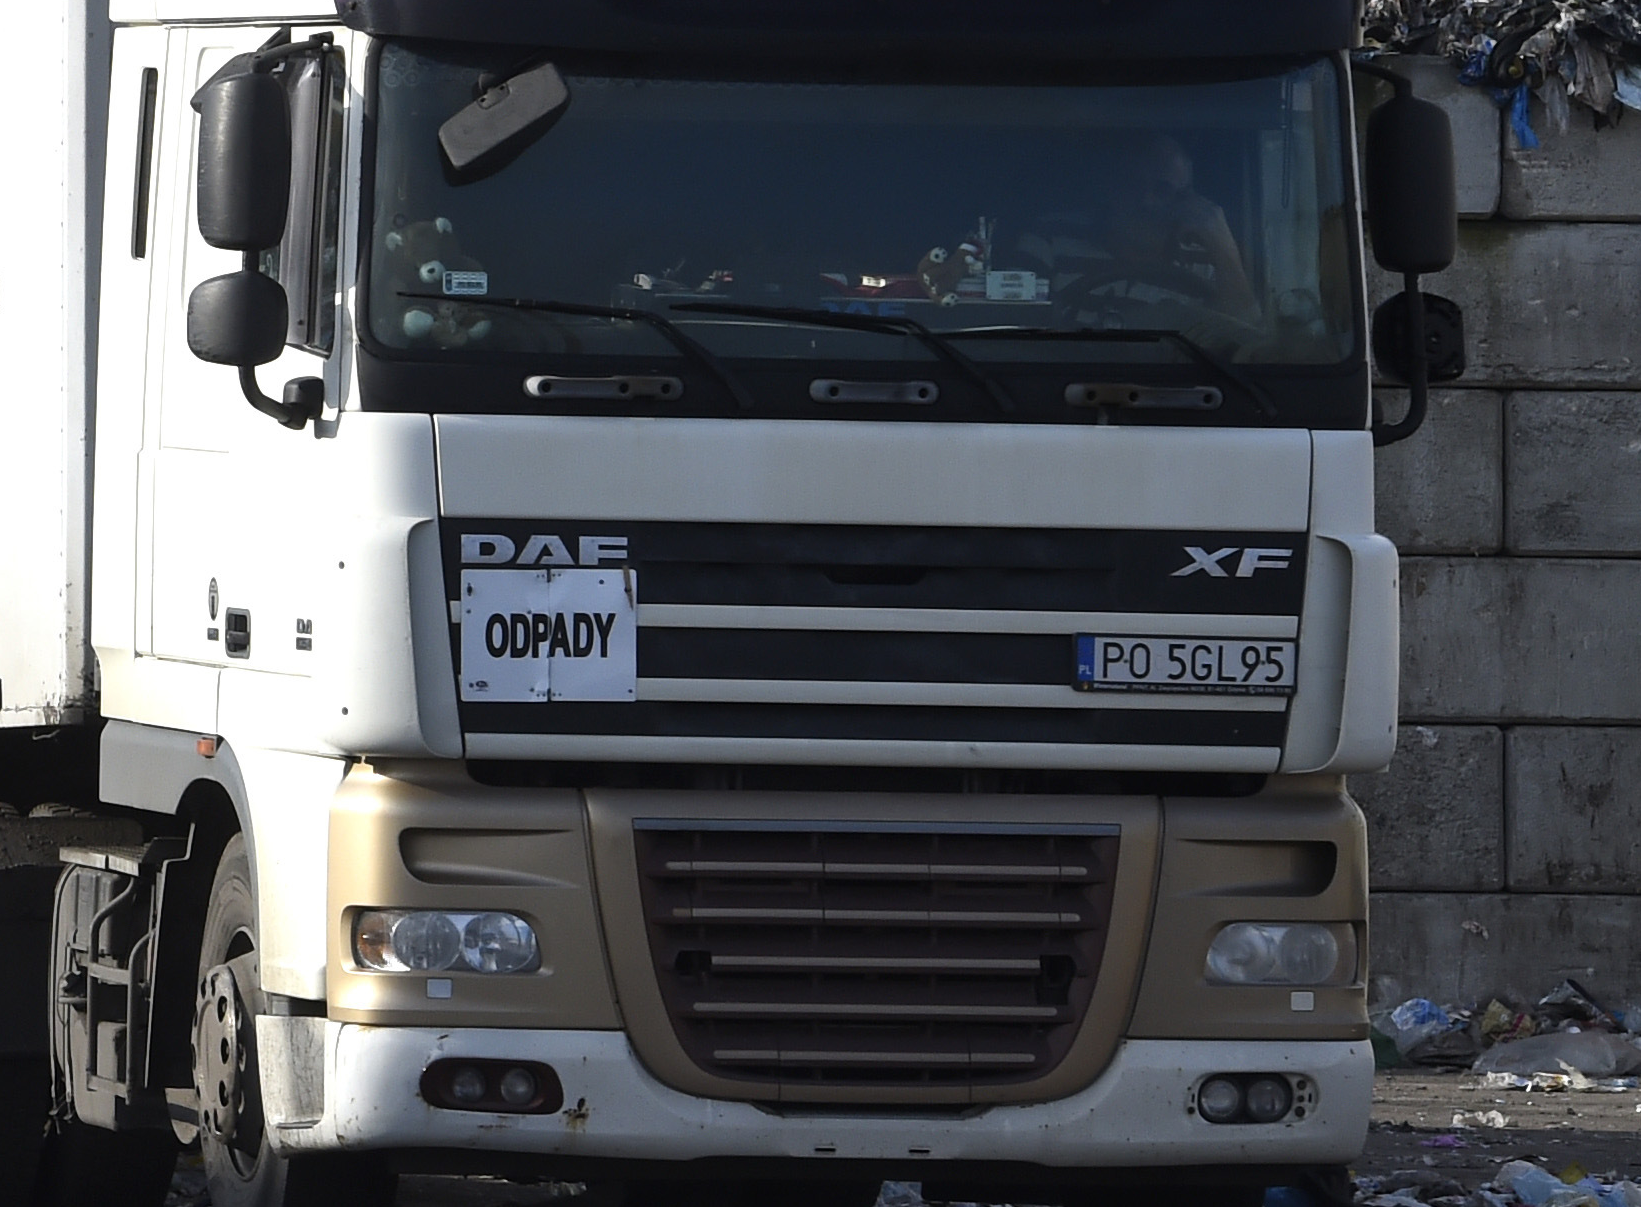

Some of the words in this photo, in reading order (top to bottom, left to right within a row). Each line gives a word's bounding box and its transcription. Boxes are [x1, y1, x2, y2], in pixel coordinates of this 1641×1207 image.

[461, 534, 628, 565] DAF
[1169, 546, 1293, 577] XF
[485, 612, 616, 658] ODPADY
[1078, 665, 1092, 675] PL
[1102, 642, 1151, 679] PO
[1167, 644, 1284, 682] 5GL95
